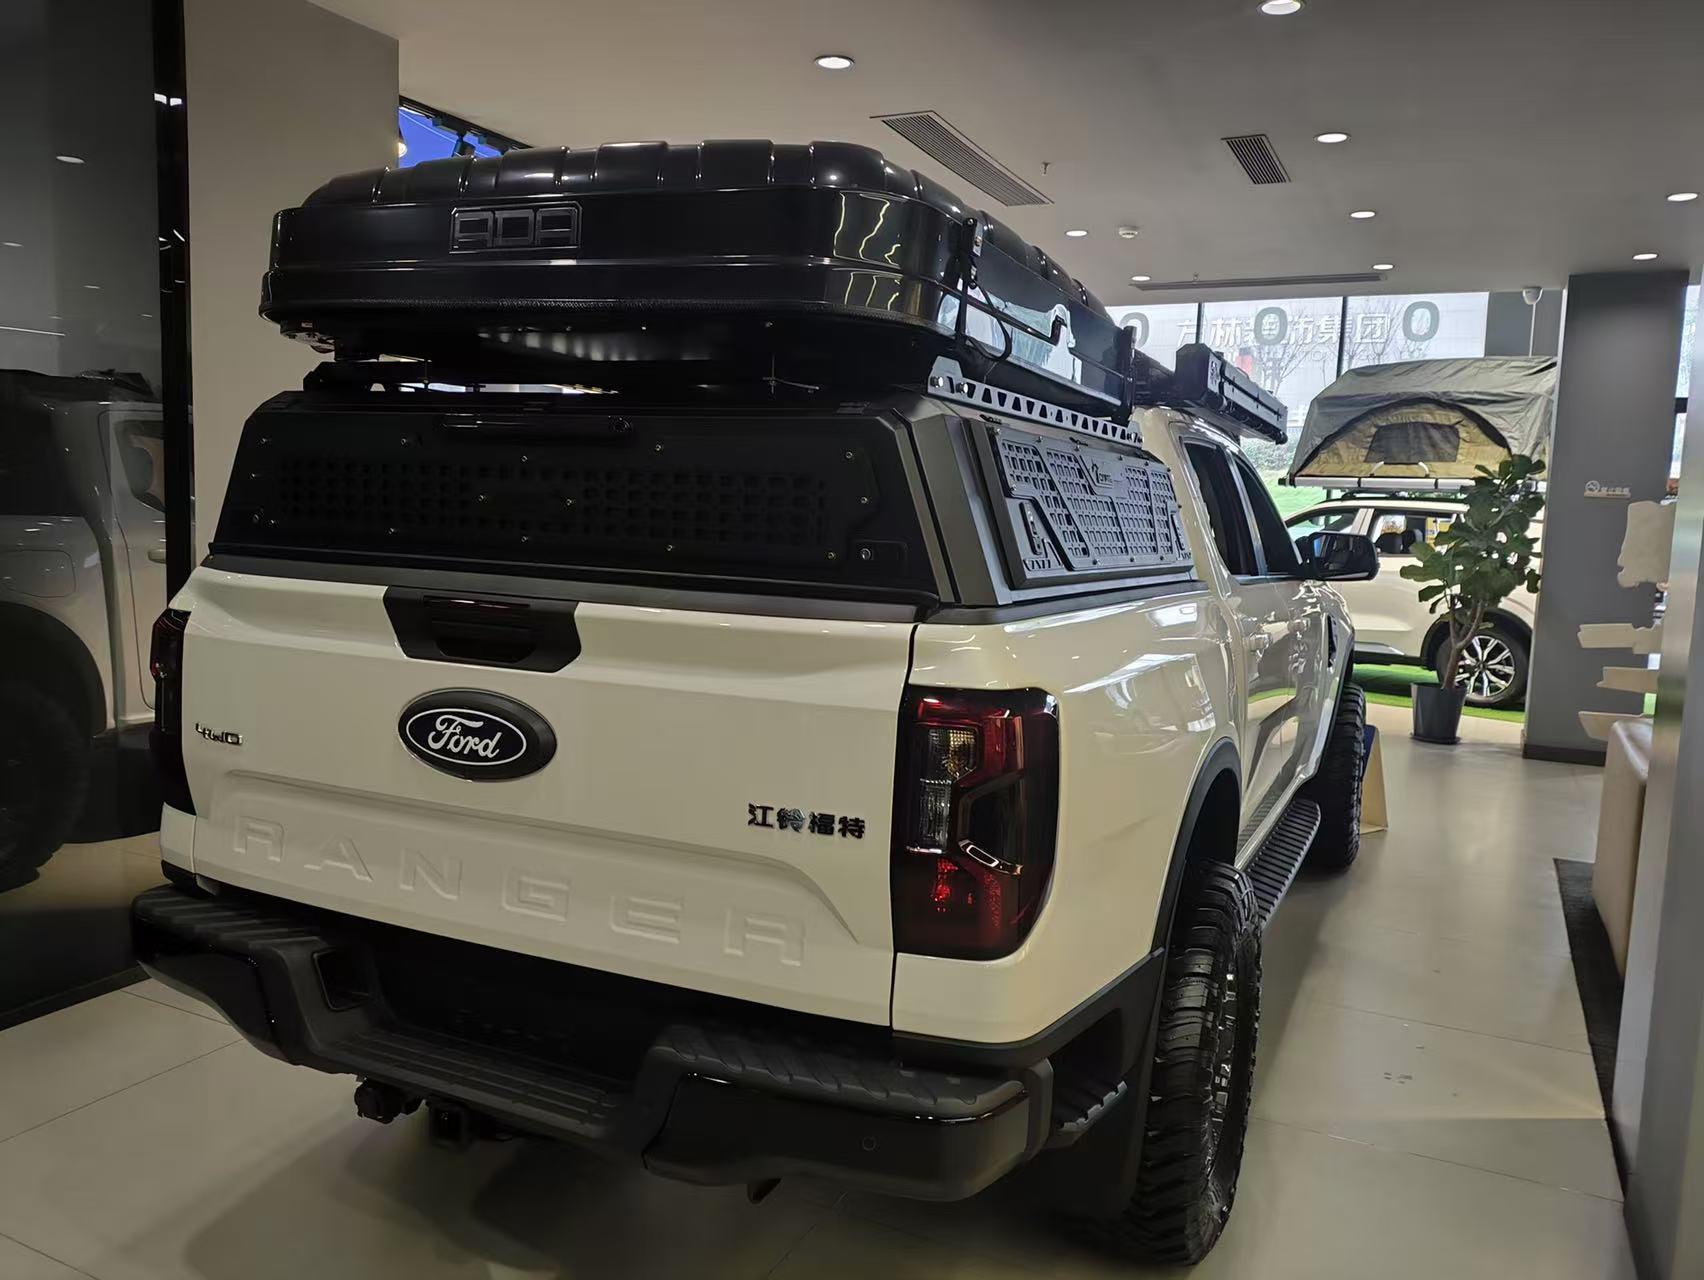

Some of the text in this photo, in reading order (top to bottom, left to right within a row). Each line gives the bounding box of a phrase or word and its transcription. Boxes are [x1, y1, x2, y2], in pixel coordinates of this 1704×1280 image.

[427, 713, 503, 759] Ford
[746, 801, 866, 840] 江铃福特
[232, 816, 806, 967] RANGER
